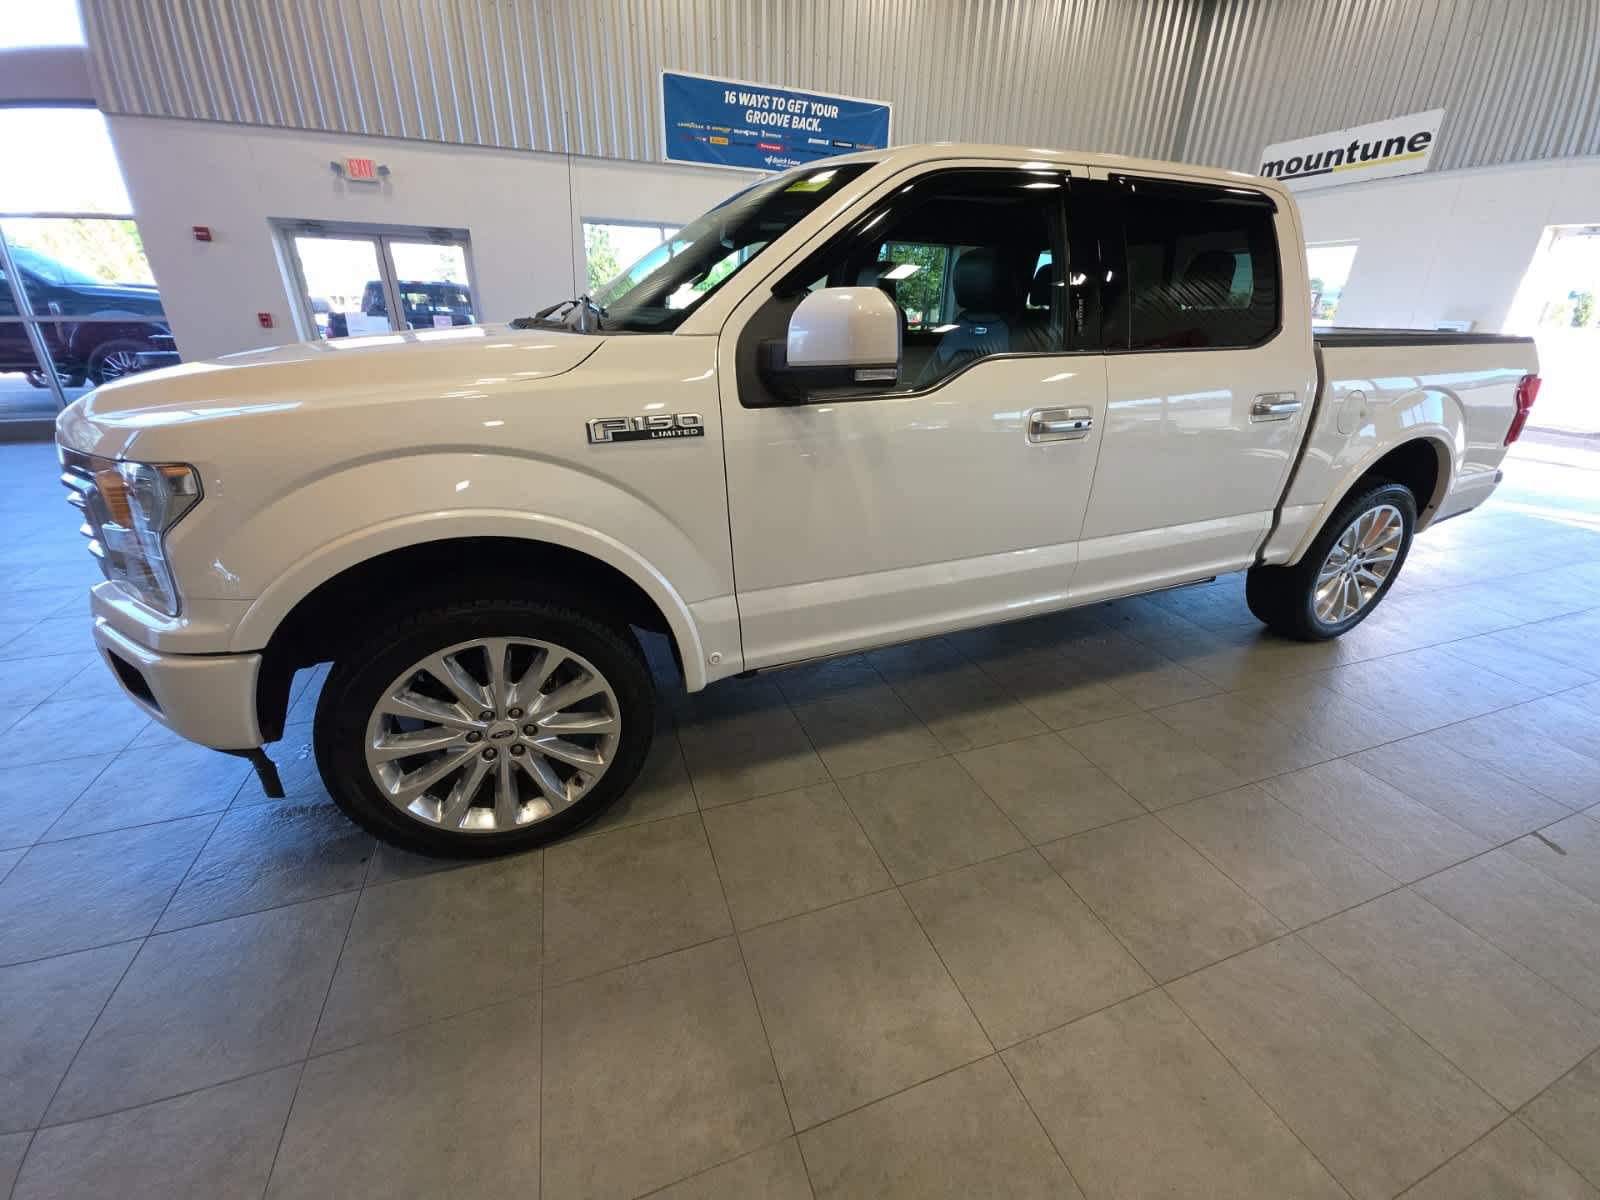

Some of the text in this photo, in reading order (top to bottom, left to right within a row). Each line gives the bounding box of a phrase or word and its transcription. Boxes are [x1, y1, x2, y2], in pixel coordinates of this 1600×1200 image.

[724, 90, 839, 119] 16 WAYS TO GET YOUR
[746, 109, 822, 132] GROOVE BACK.
[1260, 131, 1432, 177] mountune
[348, 159, 373, 177] EXIT
[651, 429, 698, 438] LIMITED
